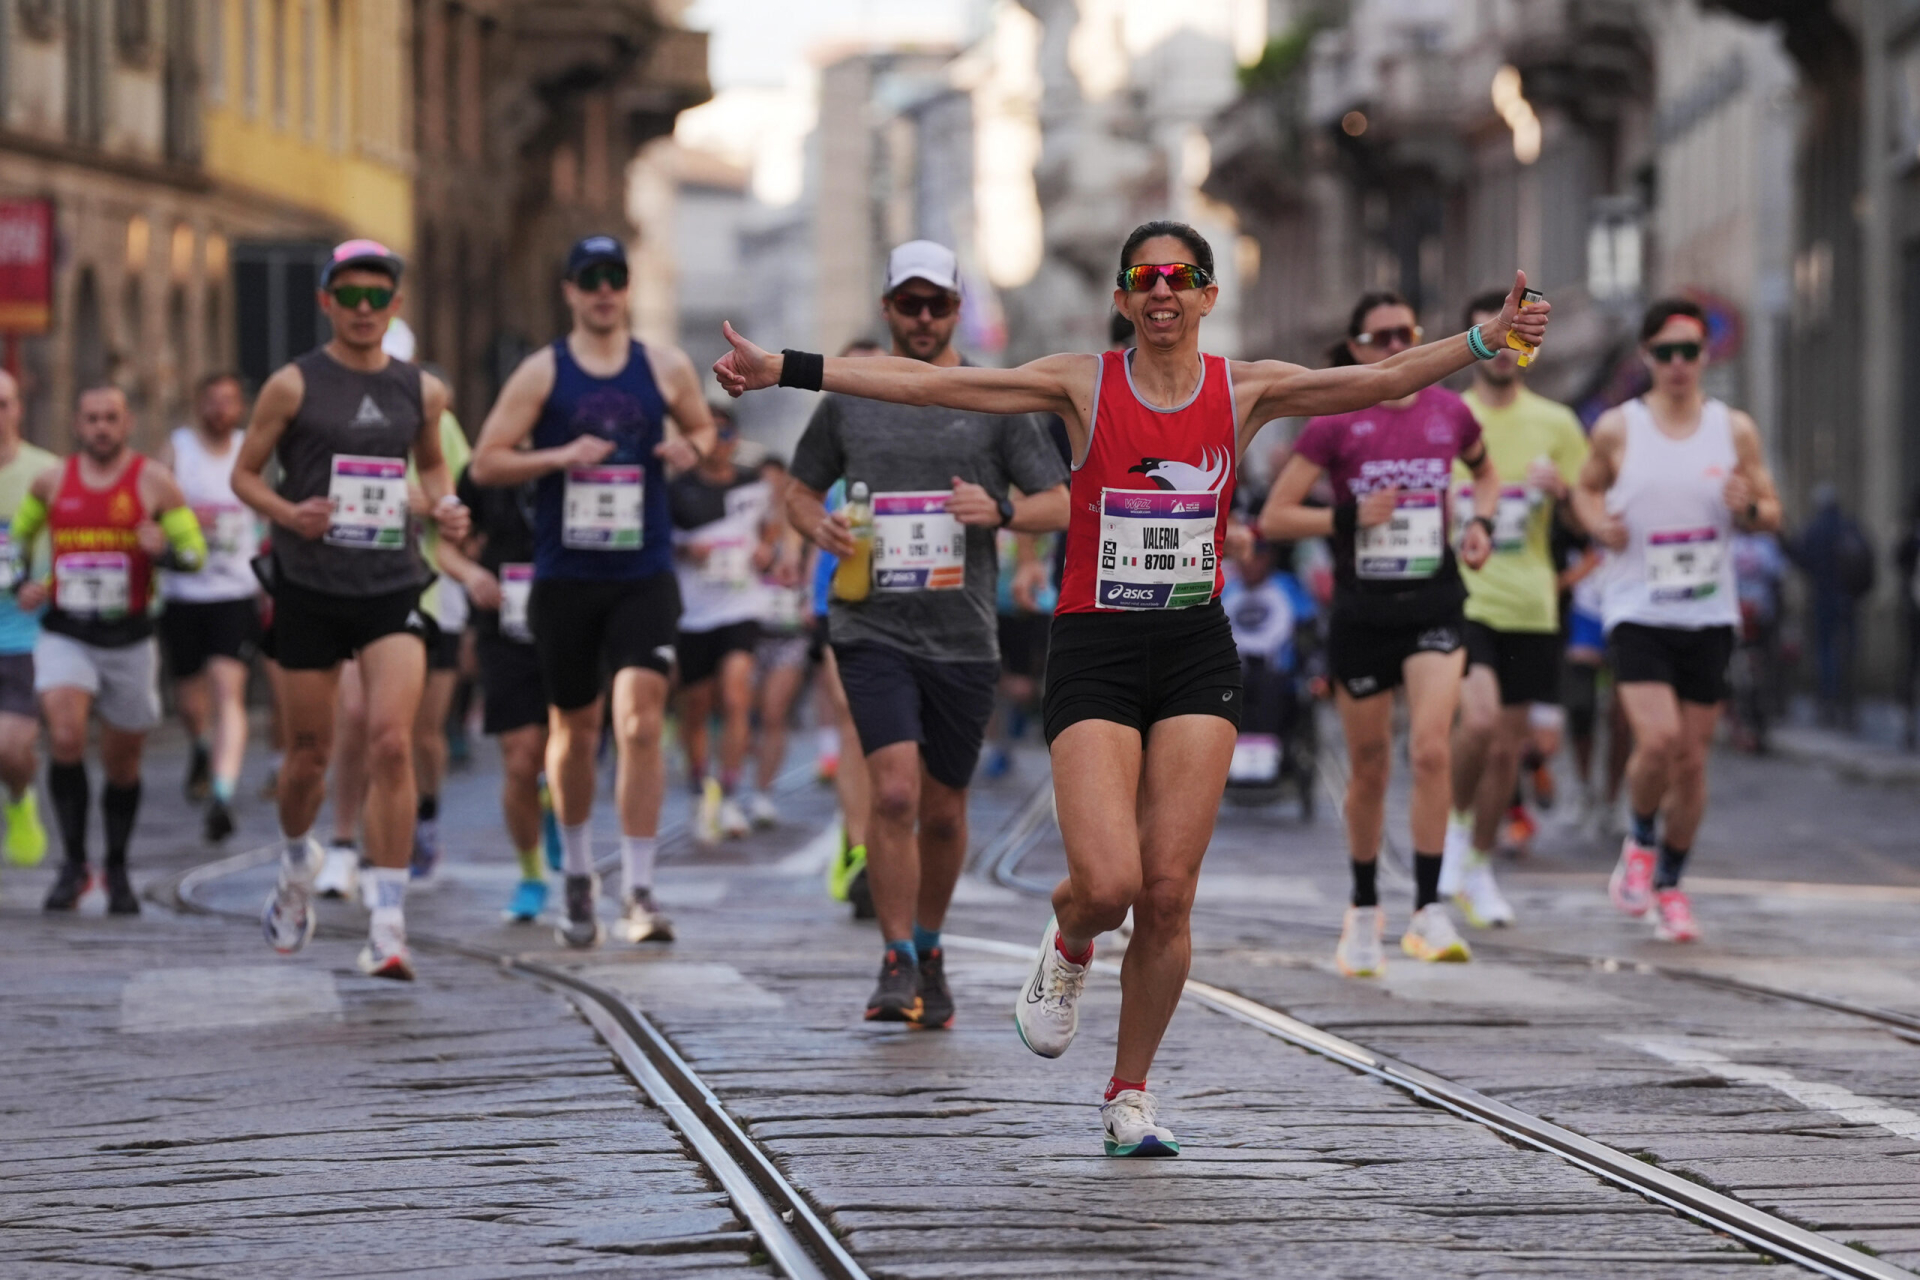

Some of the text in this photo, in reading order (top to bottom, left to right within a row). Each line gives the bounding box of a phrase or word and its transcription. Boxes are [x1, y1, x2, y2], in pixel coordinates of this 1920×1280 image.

[1361, 458, 1444, 475] SPACE
[1143, 527, 1179, 550] VALERIA
[1145, 554, 1175, 570] 8700
